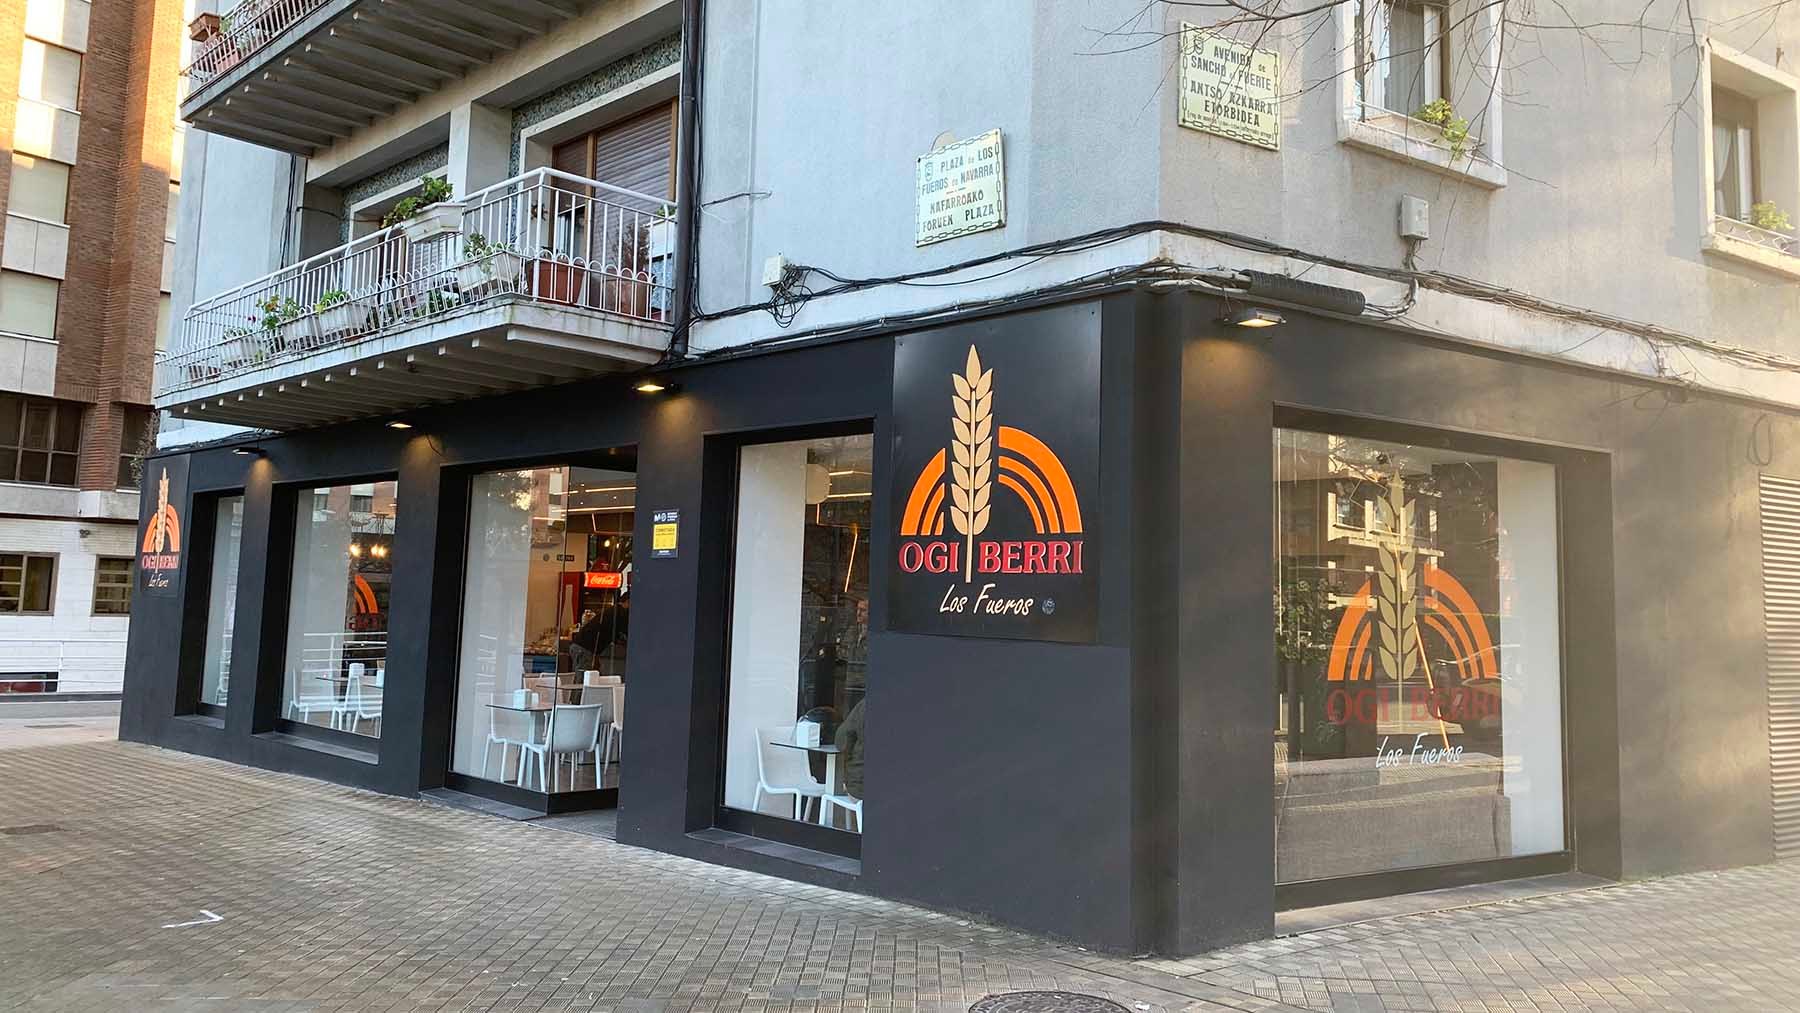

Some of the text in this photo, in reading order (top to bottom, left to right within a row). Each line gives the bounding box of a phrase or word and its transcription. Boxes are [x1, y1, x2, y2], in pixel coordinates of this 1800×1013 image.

[1214, 46, 1251, 66] AVENIDA
[1191, 56, 1226, 76] SANCHO
[1239, 70, 1271, 91] FUERTE
[1190, 80, 1273, 115] ANTSO AZKARRA
[1205, 100, 1260, 127] ETORBIDEA
[940, 156, 964, 173] PLAZA
[978, 146, 993, 161] LOS
[922, 177, 948, 196] FUEROS
[960, 164, 994, 184] NAVARRA
[930, 189, 984, 215] NAFARROAKO
[923, 204, 994, 233] FORUEN PLAZA
[898, 540, 1084, 574] OGI BERRI
[939, 583, 1034, 616] Los Fueros
[1326, 688, 1390, 726] OGI
[1376, 732, 1464, 769] Los Fueros
